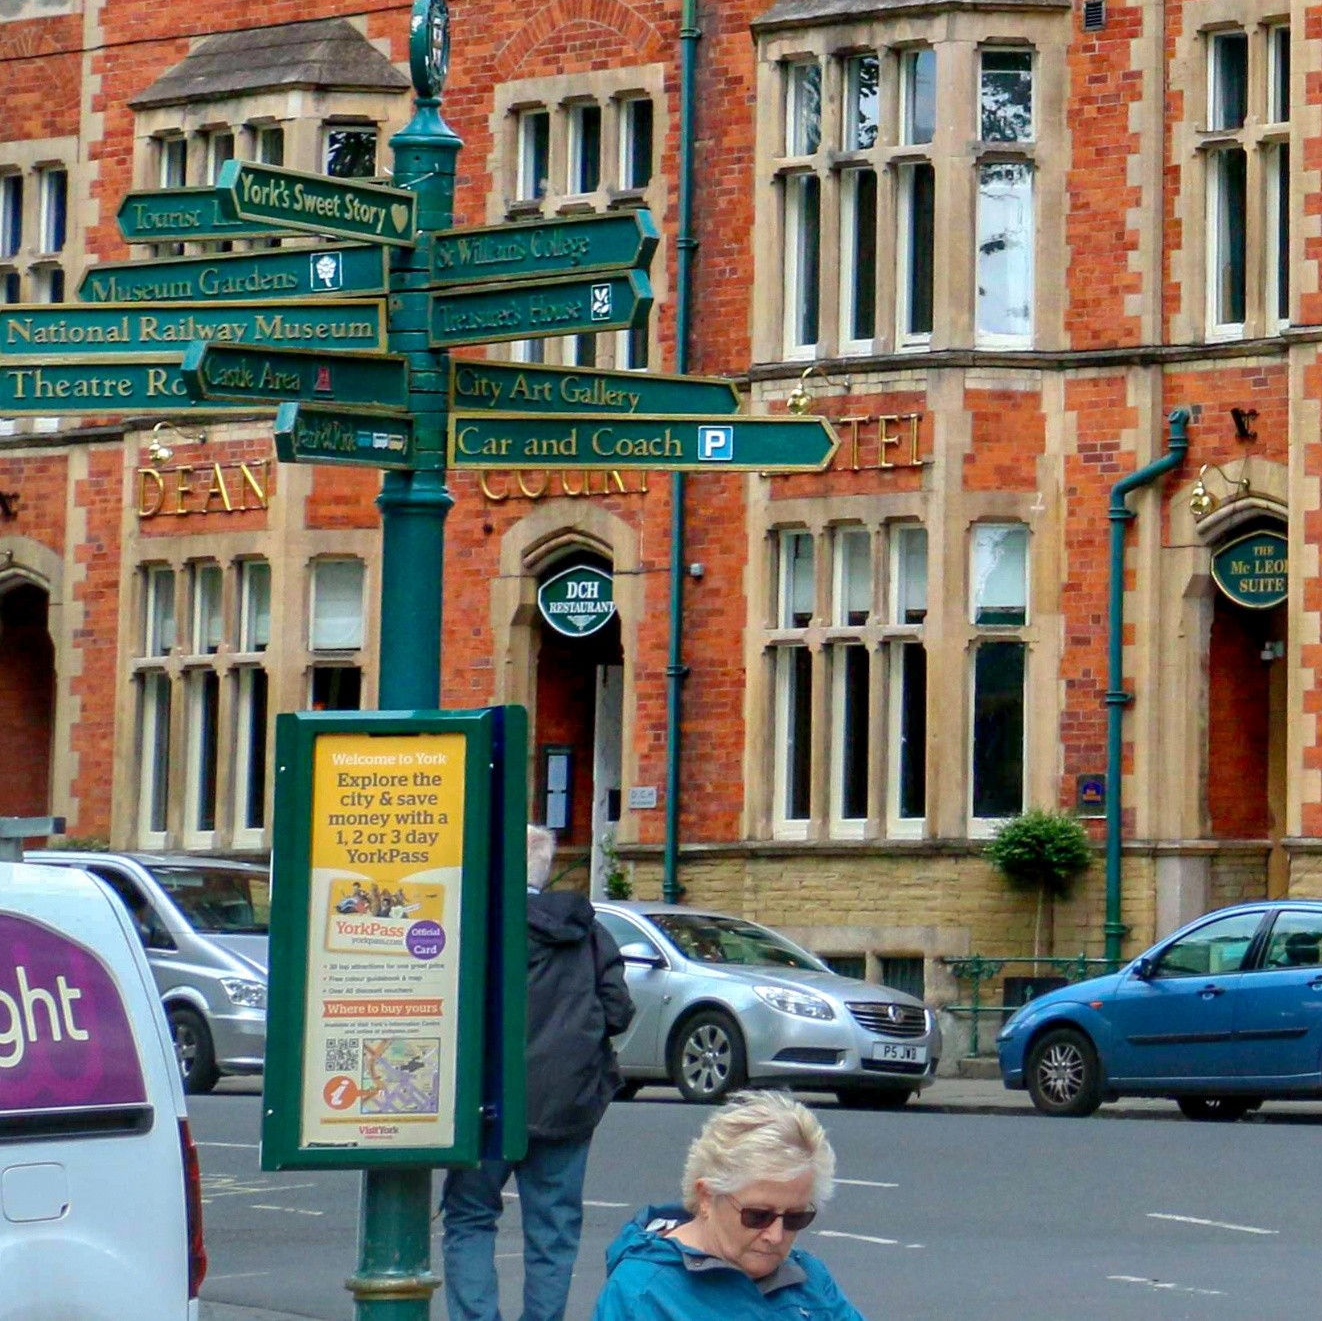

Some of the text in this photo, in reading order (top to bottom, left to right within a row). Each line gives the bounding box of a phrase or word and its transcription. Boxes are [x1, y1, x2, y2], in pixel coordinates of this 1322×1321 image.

[240, 173, 386, 233] York's Sweet Story
[133, 203, 200, 229] Tourist
[530, 229, 590, 265] College
[92, 266, 298, 302] Museum Gardens
[6, 315, 374, 345] National Railway Museum
[205, 356, 300, 391] Castle Area
[8, 368, 133, 399] Theatre
[455, 368, 640, 414] City Art Gallery
[458, 427, 726, 458] Car and Coach P
[138, 460, 271, 519] DEAN
[1253, 546, 1274, 556] THE
[1231, 561, 1250, 575] Mc
[566, 581, 600, 599] DCH
[1239, 578, 1284, 592] SUITE
[549, 601, 616, 614] RESTAURANT
[332, 753, 447, 766] Welcome to York
[337, 772, 442, 790] Explore the
[340, 791, 438, 810] city & save
[328, 811, 448, 827] money with a
[336, 830, 439, 846] 1, 2 or 3 day
[346, 849, 429, 864] YorkPass
[336, 921, 404, 938] YorkPass
[411, 928, 441, 937] Official
[413, 945, 437, 954] Card
[327, 1003, 438, 1017] Where to buy yours
[884, 1045, 898, 1058] P5
